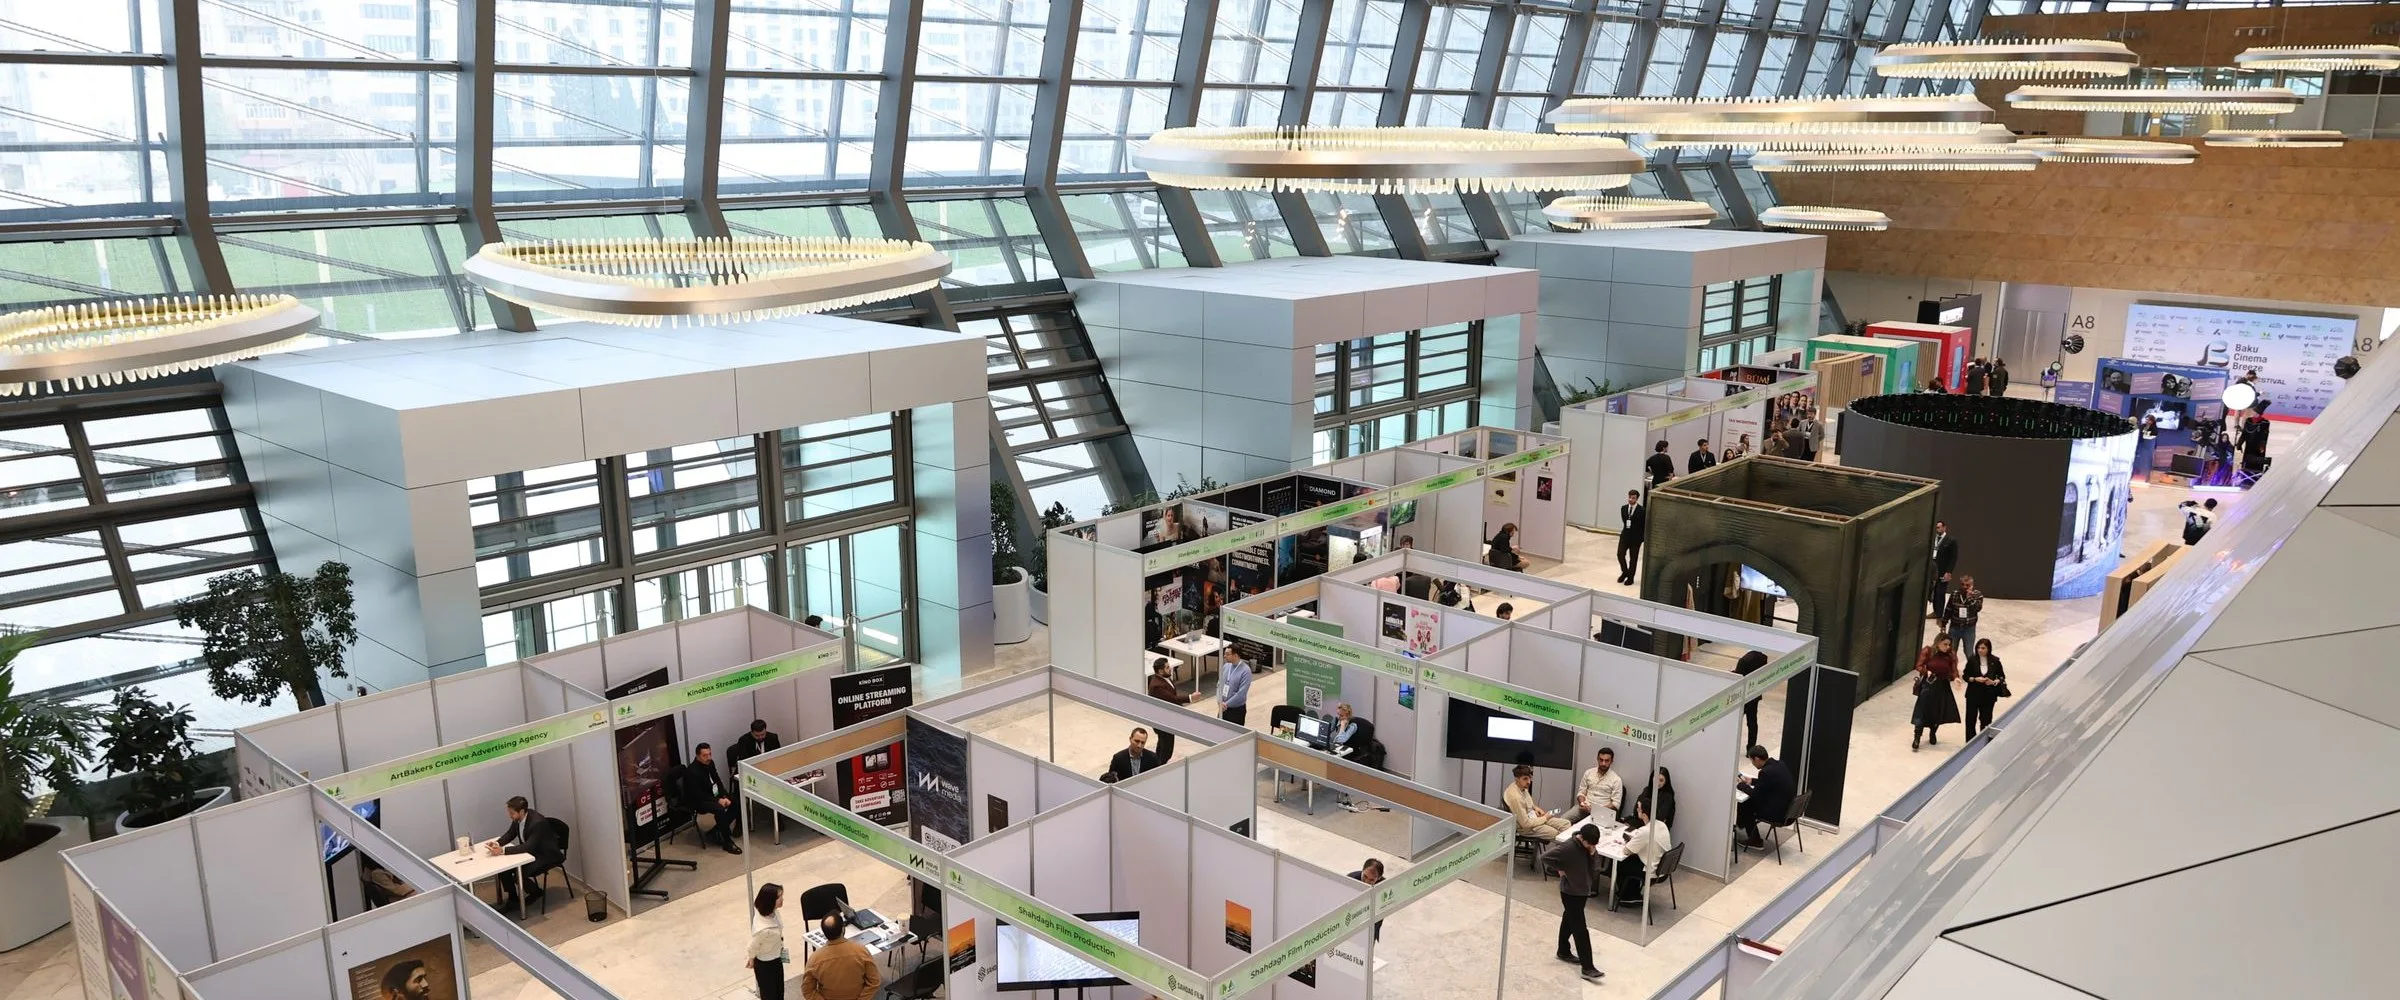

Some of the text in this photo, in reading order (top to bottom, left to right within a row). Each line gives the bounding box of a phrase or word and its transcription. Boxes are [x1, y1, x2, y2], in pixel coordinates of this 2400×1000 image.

[2072, 314, 2095, 329] A8
[2235, 343, 2259, 353] Baku
[2233, 353, 2268, 363] Cinema
[2232, 362, 2263, 372] Breeze
[1309, 486, 1336, 496] DIAMOND
[1270, 630, 1361, 660] Azerbaijan Animation Association
[1385, 661, 1414, 675] anima
[687, 667, 778, 697] Kinobox Streaming Platform
[872, 676, 883, 684] BOX
[838, 686, 907, 705] ONLINE STREAMING
[854, 697, 892, 711] PLATFORM
[1503, 694, 1560, 715] 3Dost Animation
[1631, 728, 1656, 743] 3Dost
[390, 731, 549, 781] ArtBakers Creative Advertising Agency
[941, 780, 960, 793] wave
[941, 788, 962, 802] media
[803, 804, 870, 841] Wave Media Production
[926, 861, 938, 870] wave
[1413, 848, 1480, 887] Chinar Film Production
[1018, 905, 1055, 929] Shahdagh
[1055, 923, 1073, 937] Film
[1073, 931, 1116, 958] Production
[1250, 922, 1340, 980] Shahdagh Film Production
